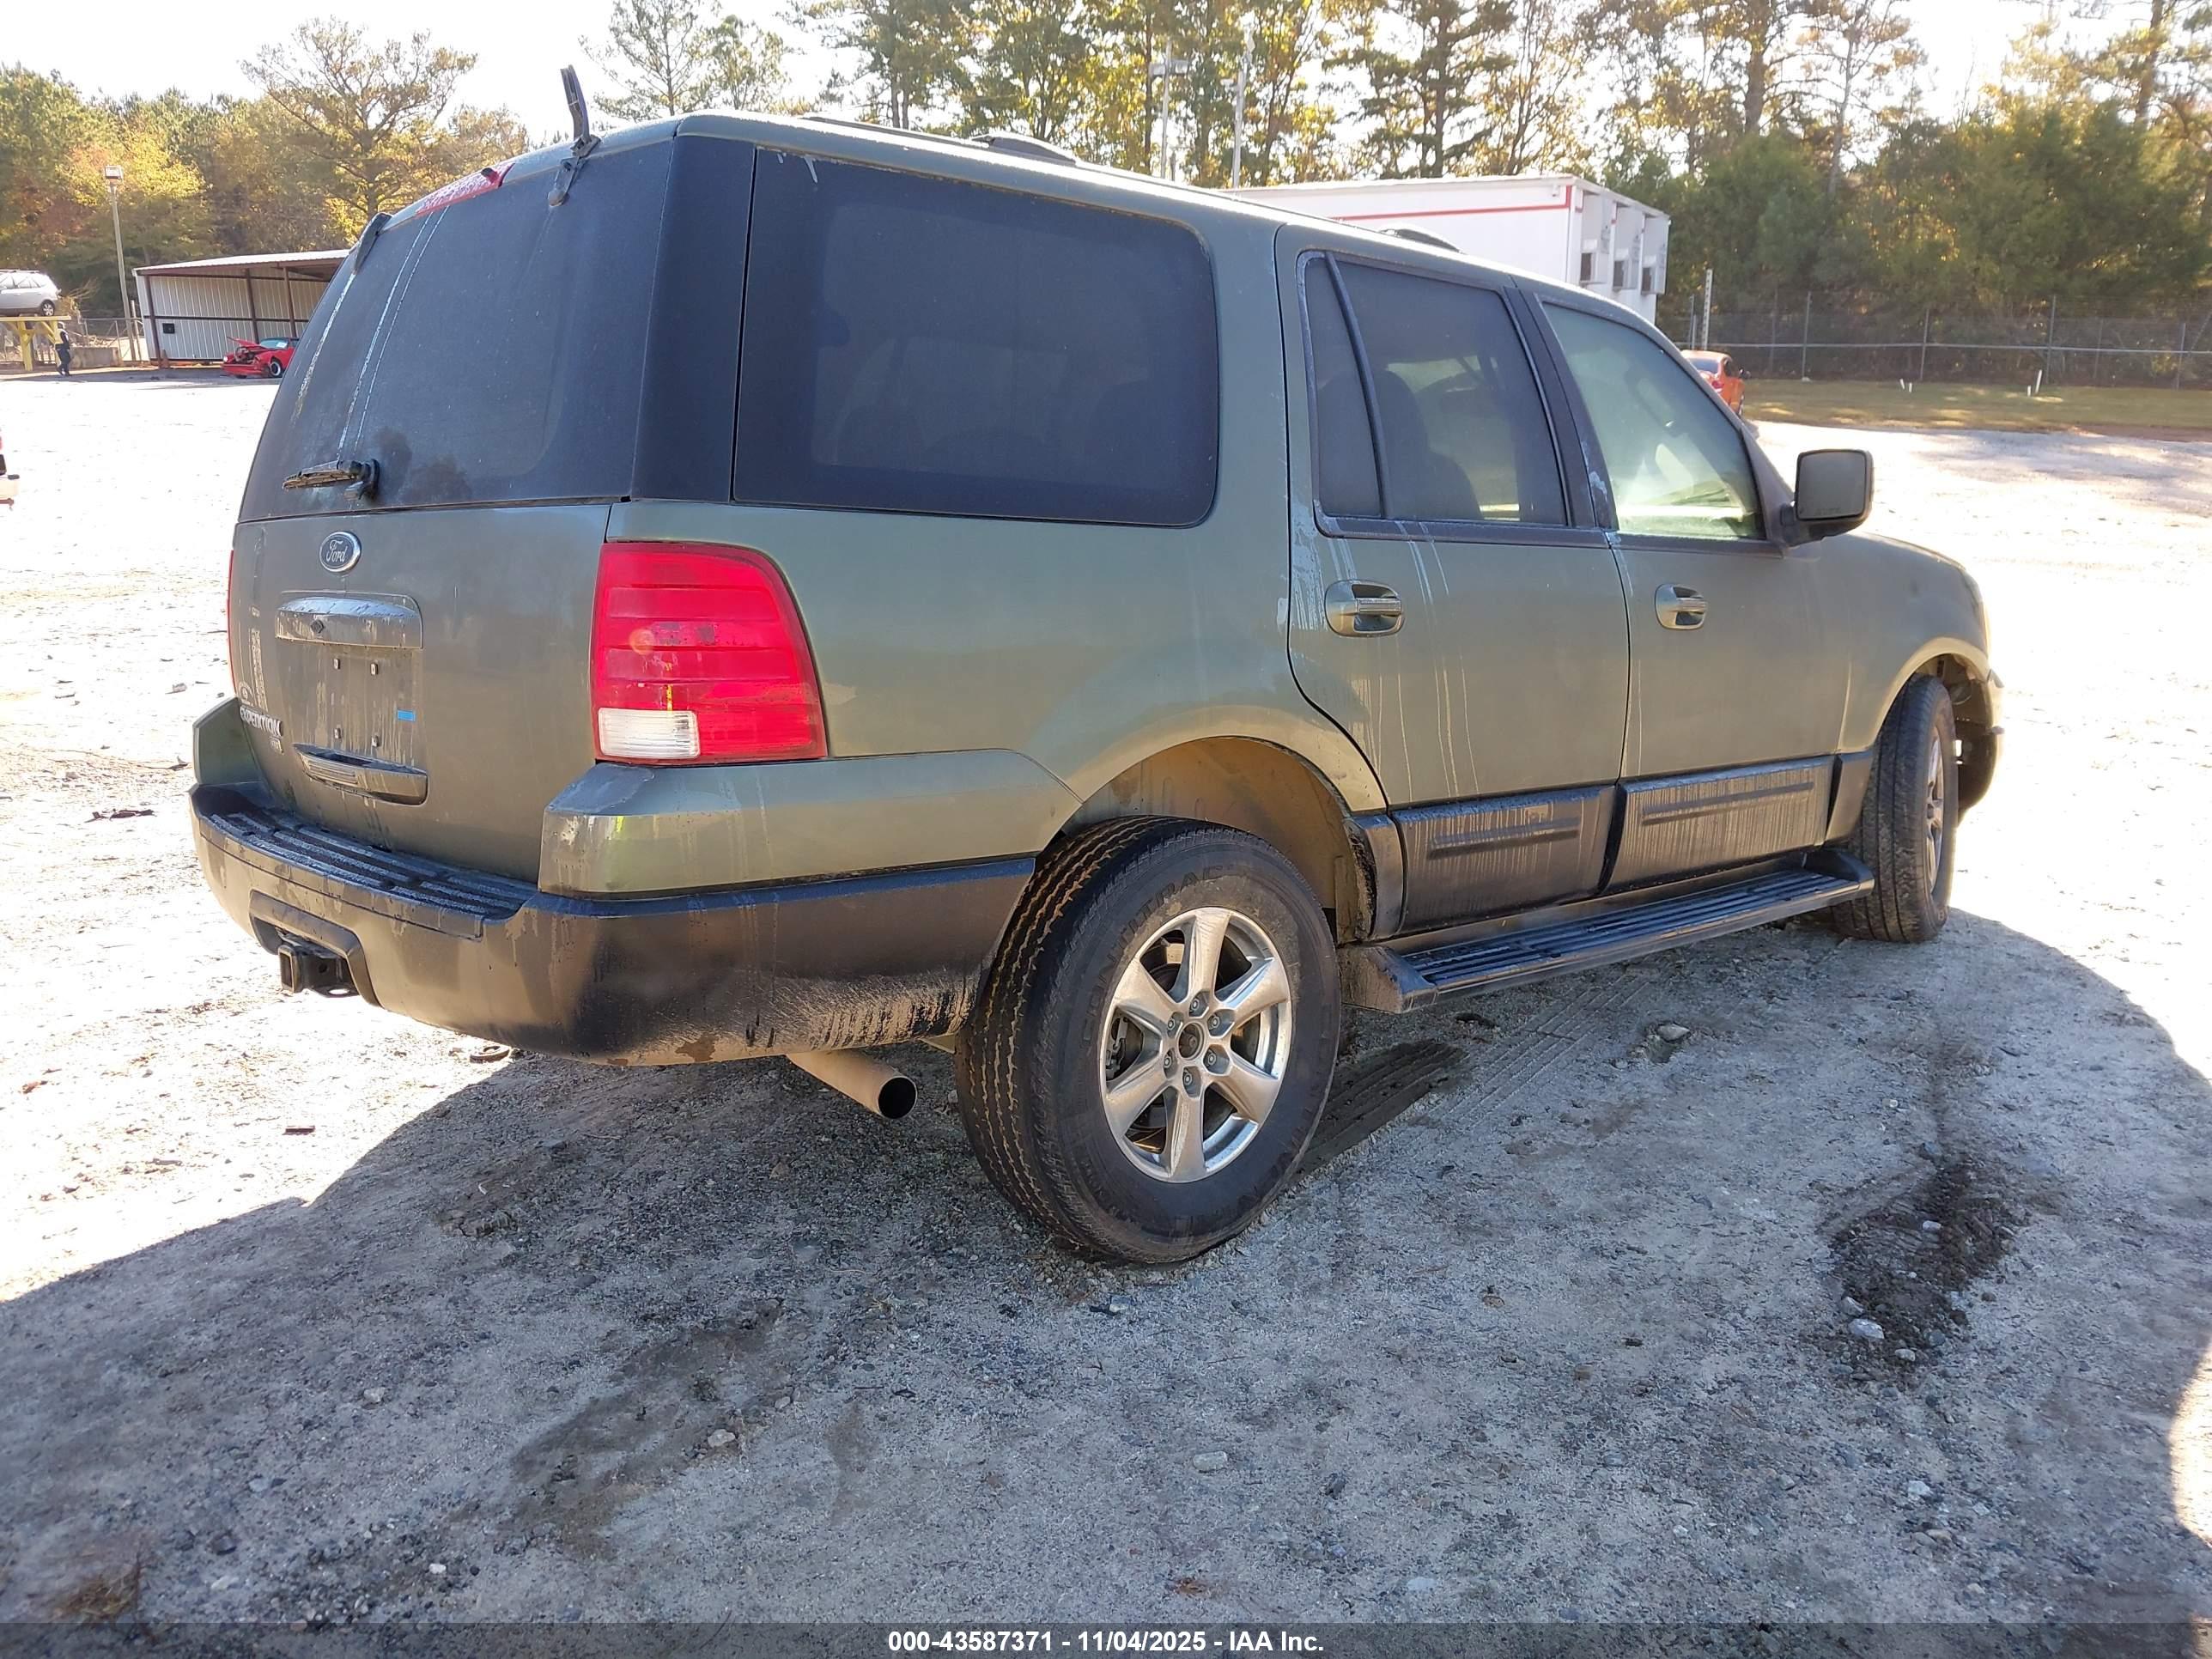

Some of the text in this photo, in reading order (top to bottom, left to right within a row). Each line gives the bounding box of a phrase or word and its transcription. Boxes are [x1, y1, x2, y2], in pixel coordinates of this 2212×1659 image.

[325, 539, 349, 562] Ford
[239, 704, 282, 738] EXPEDITION
[1082, 864, 1224, 1042] CONTITRAC
